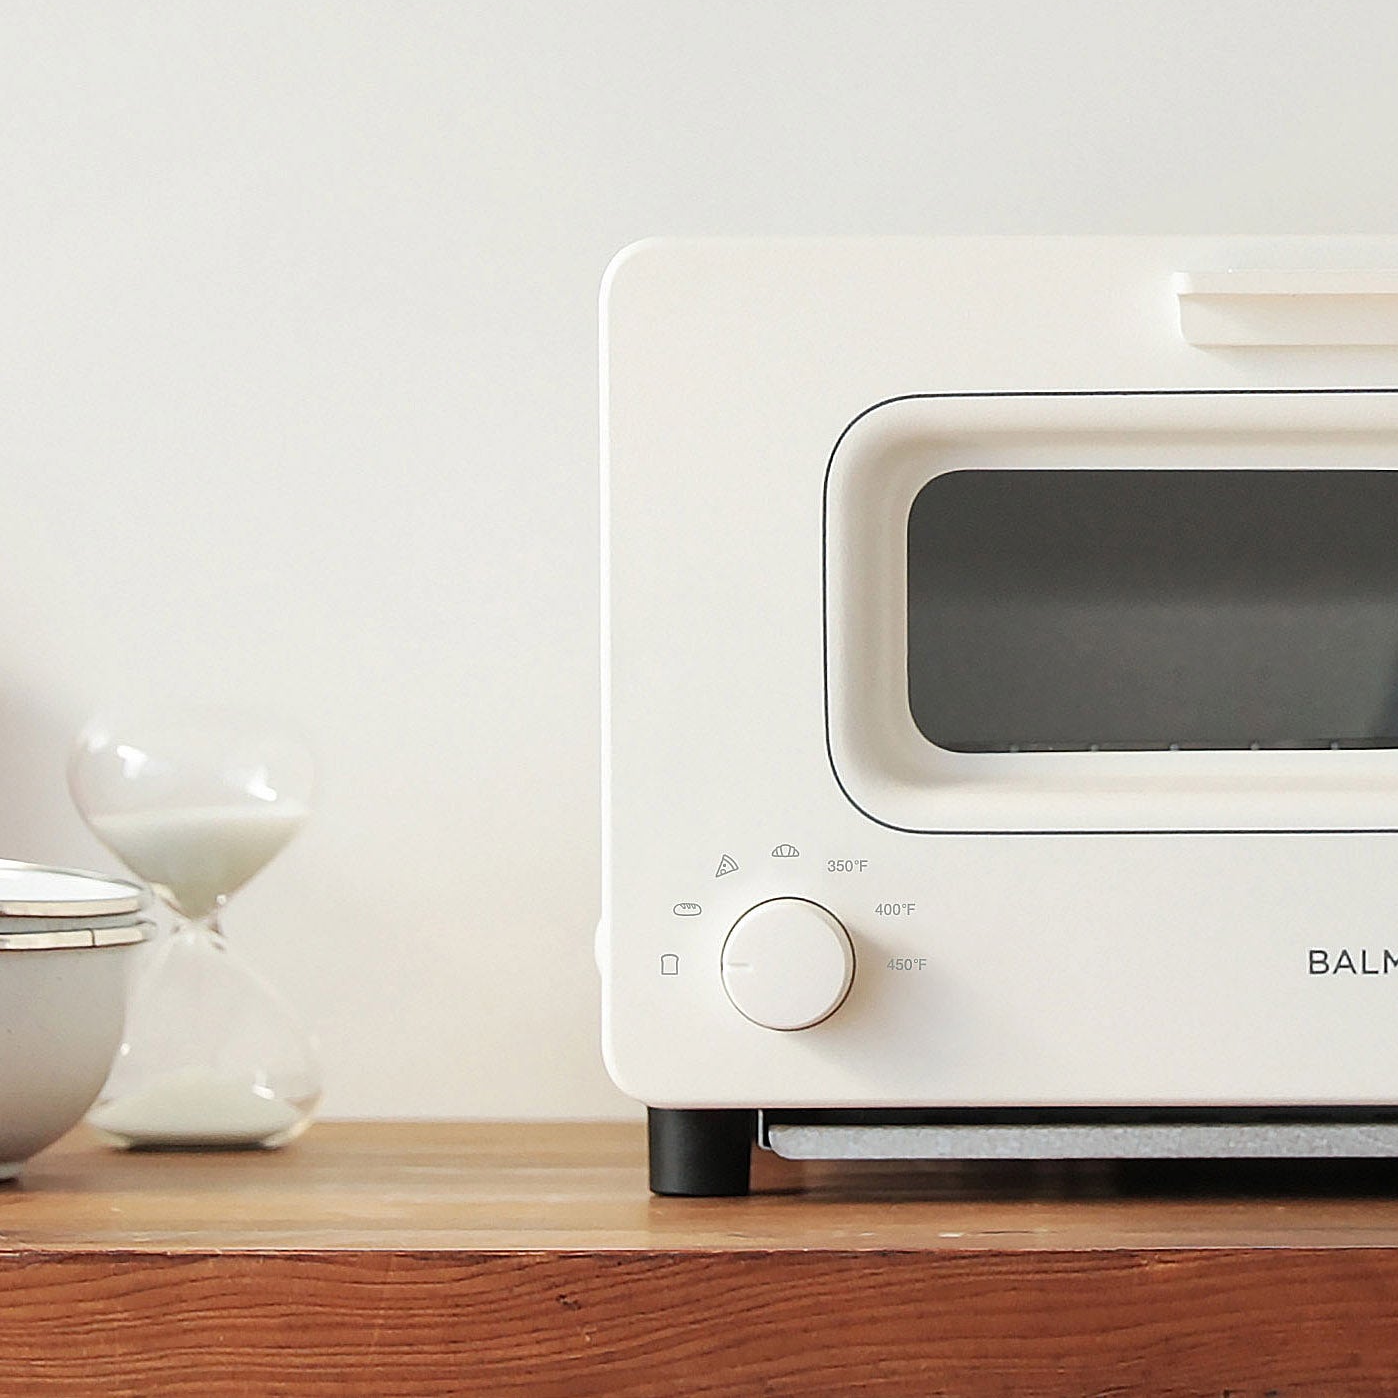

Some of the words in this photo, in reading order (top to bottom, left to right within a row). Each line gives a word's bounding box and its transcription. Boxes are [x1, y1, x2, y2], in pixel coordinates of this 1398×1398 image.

[827, 859, 869, 873] 350°F
[874, 903, 916, 916] 400°F
[886, 958, 927, 971] 450°F
